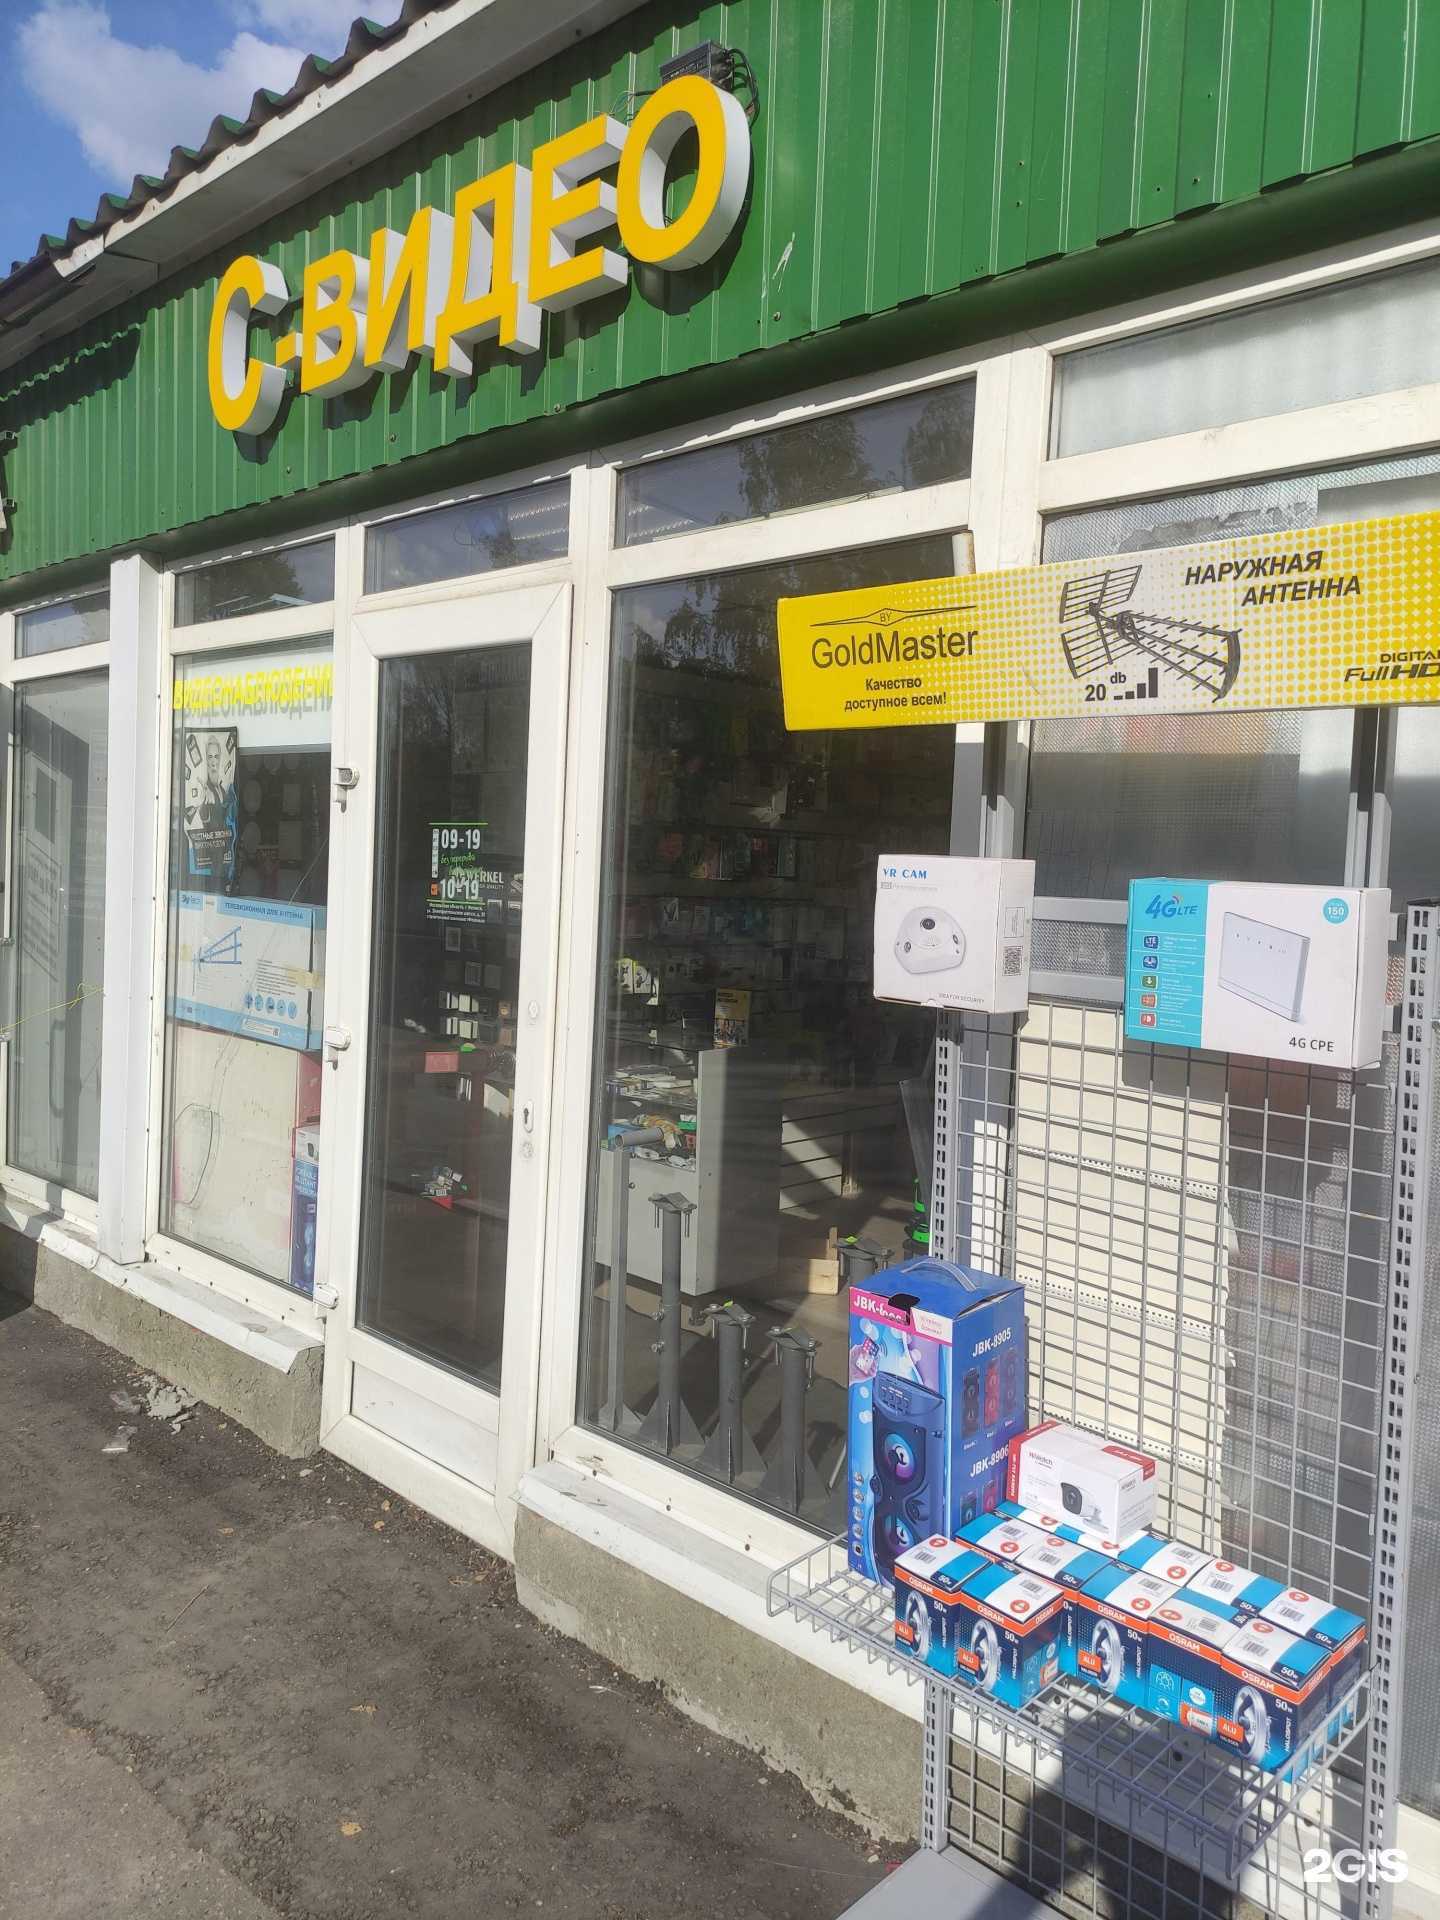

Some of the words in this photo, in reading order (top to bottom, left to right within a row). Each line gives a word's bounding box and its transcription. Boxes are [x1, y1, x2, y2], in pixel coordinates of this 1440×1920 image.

[208, 75, 750, 435] С-ВИДЕО
[1185, 550, 1323, 586] НАРУЖНАЯ
[1241, 575, 1361, 607] АНТЕННА
[880, 611, 892, 623] BY
[812, 627, 978, 668] GoldMaster
[865, 677, 922, 691] Качество
[1110, 671, 1127, 684] db
[844, 697, 908, 713] доступное
[911, 692, 947, 707] всем!
[1084, 684, 1107, 702] 20
[441, 829, 480, 849] 09-19
[883, 868, 897, 878] VR
[902, 869, 928, 879] CAM
[440, 878, 479, 900] 10-19
[1328, 906, 1344, 916] 150
[1289, 1037, 1306, 1049] 4G
[1310, 1039, 1335, 1053] CPE
[972, 1327, 1011, 1357] JBK-8905
[908, 1576, 933, 1595] OSRAM
[977, 1604, 1005, 1625] OSRAM
[1097, 1605, 1127, 1623] OSRAM
[1169, 1632, 1201, 1652] OSRAM
[1083, 1657, 1096, 1667] ALU
[1241, 1670, 1275, 1692] OSRAM
[1222, 1722, 1237, 1735] ALU
